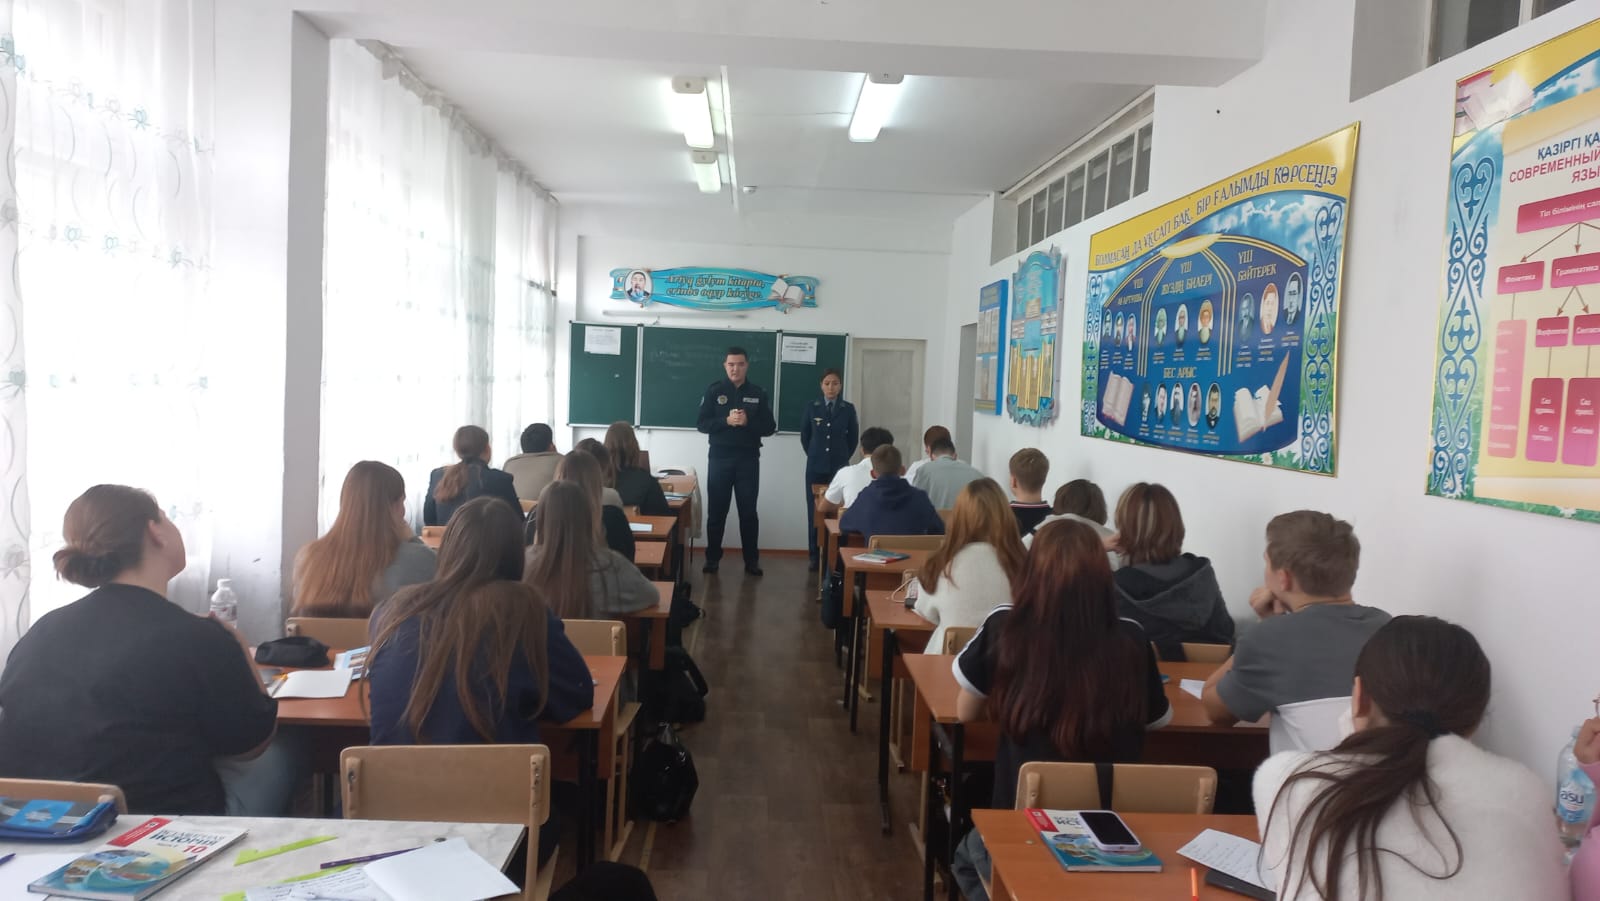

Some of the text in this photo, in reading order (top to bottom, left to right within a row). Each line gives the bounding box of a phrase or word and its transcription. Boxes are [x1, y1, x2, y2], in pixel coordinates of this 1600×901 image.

[1537, 137, 1581, 160] ҚАЗІРГІ
[1196, 195, 1211, 216] БІР
[1213, 169, 1270, 206] ҒАЛЫМДЫ
[1274, 164, 1338, 188] КӨРСЕҢІЗ
[1560, 790, 1585, 804] asu
[149, 832, 219, 846] ИСТОРИЯ
[183, 845, 208, 854] 10
